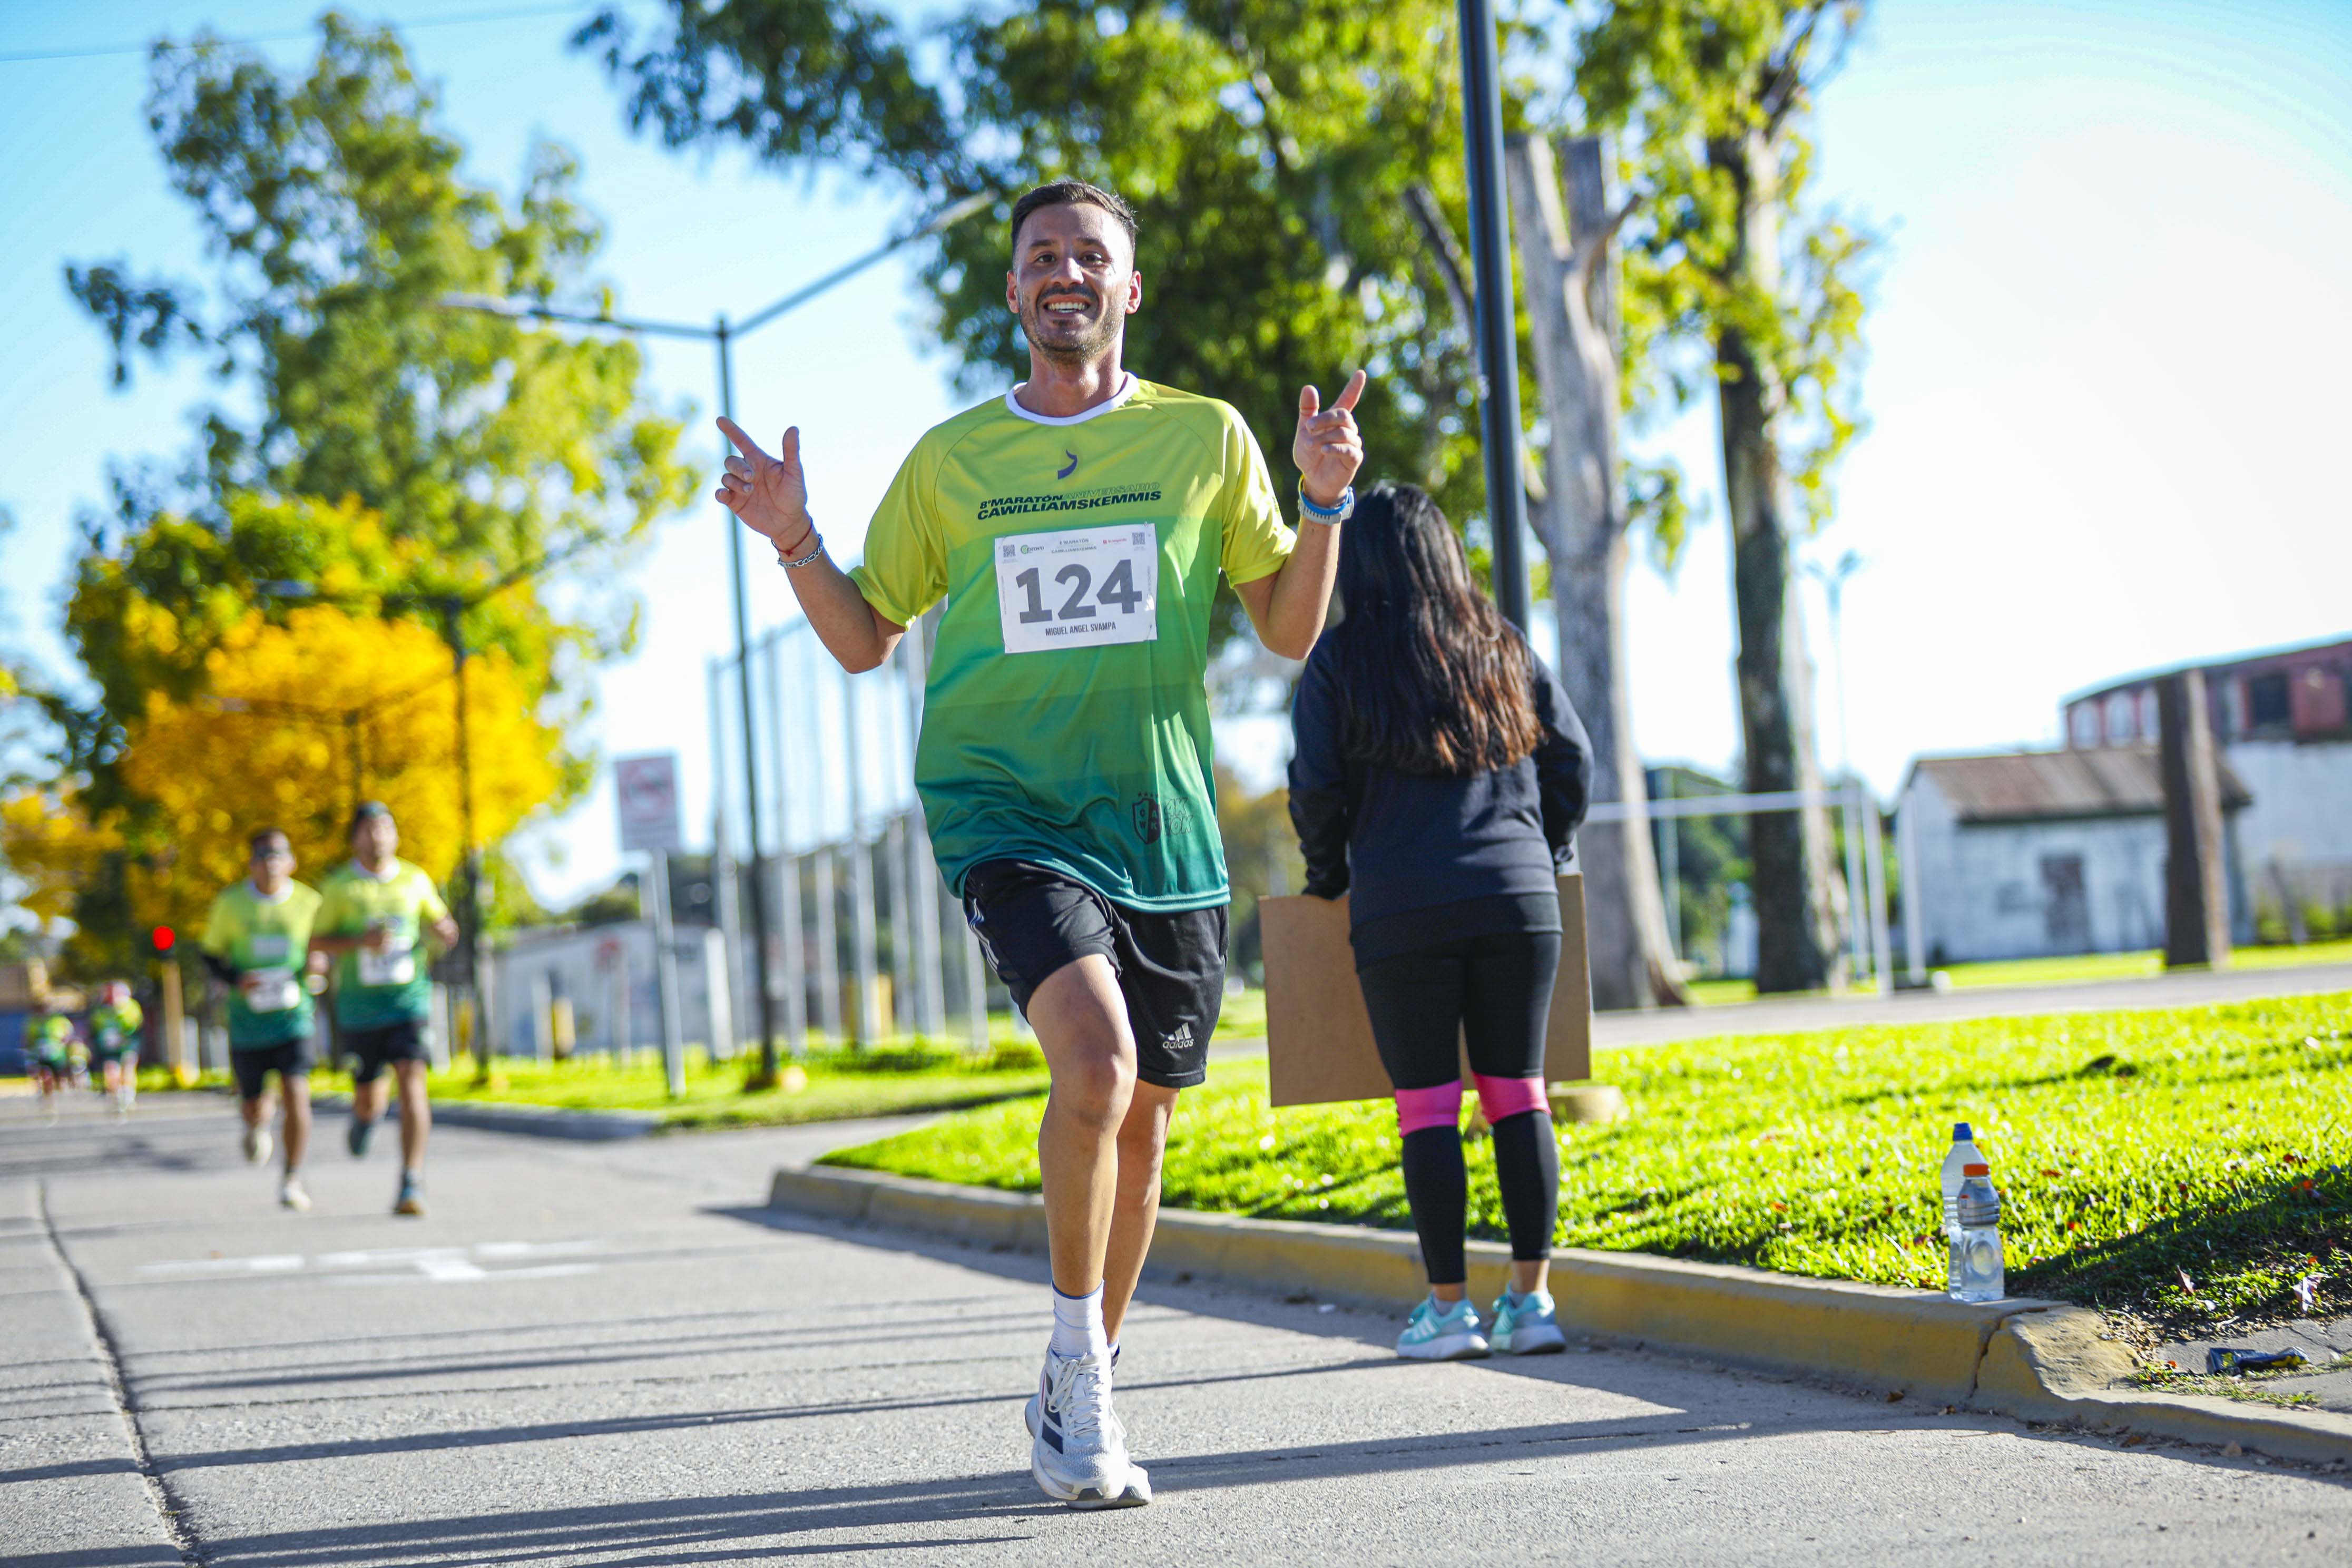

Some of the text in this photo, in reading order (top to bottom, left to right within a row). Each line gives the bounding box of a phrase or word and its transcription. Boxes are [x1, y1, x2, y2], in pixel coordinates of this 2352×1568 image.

[977, 491, 1162, 521] CAWILLIAMSKEMMIS
[1016, 558, 1142, 624] 124
[1045, 622, 1116, 636] MIGUEL ANGEL SVAMPA
[1162, 1038, 1194, 1049] adidas
